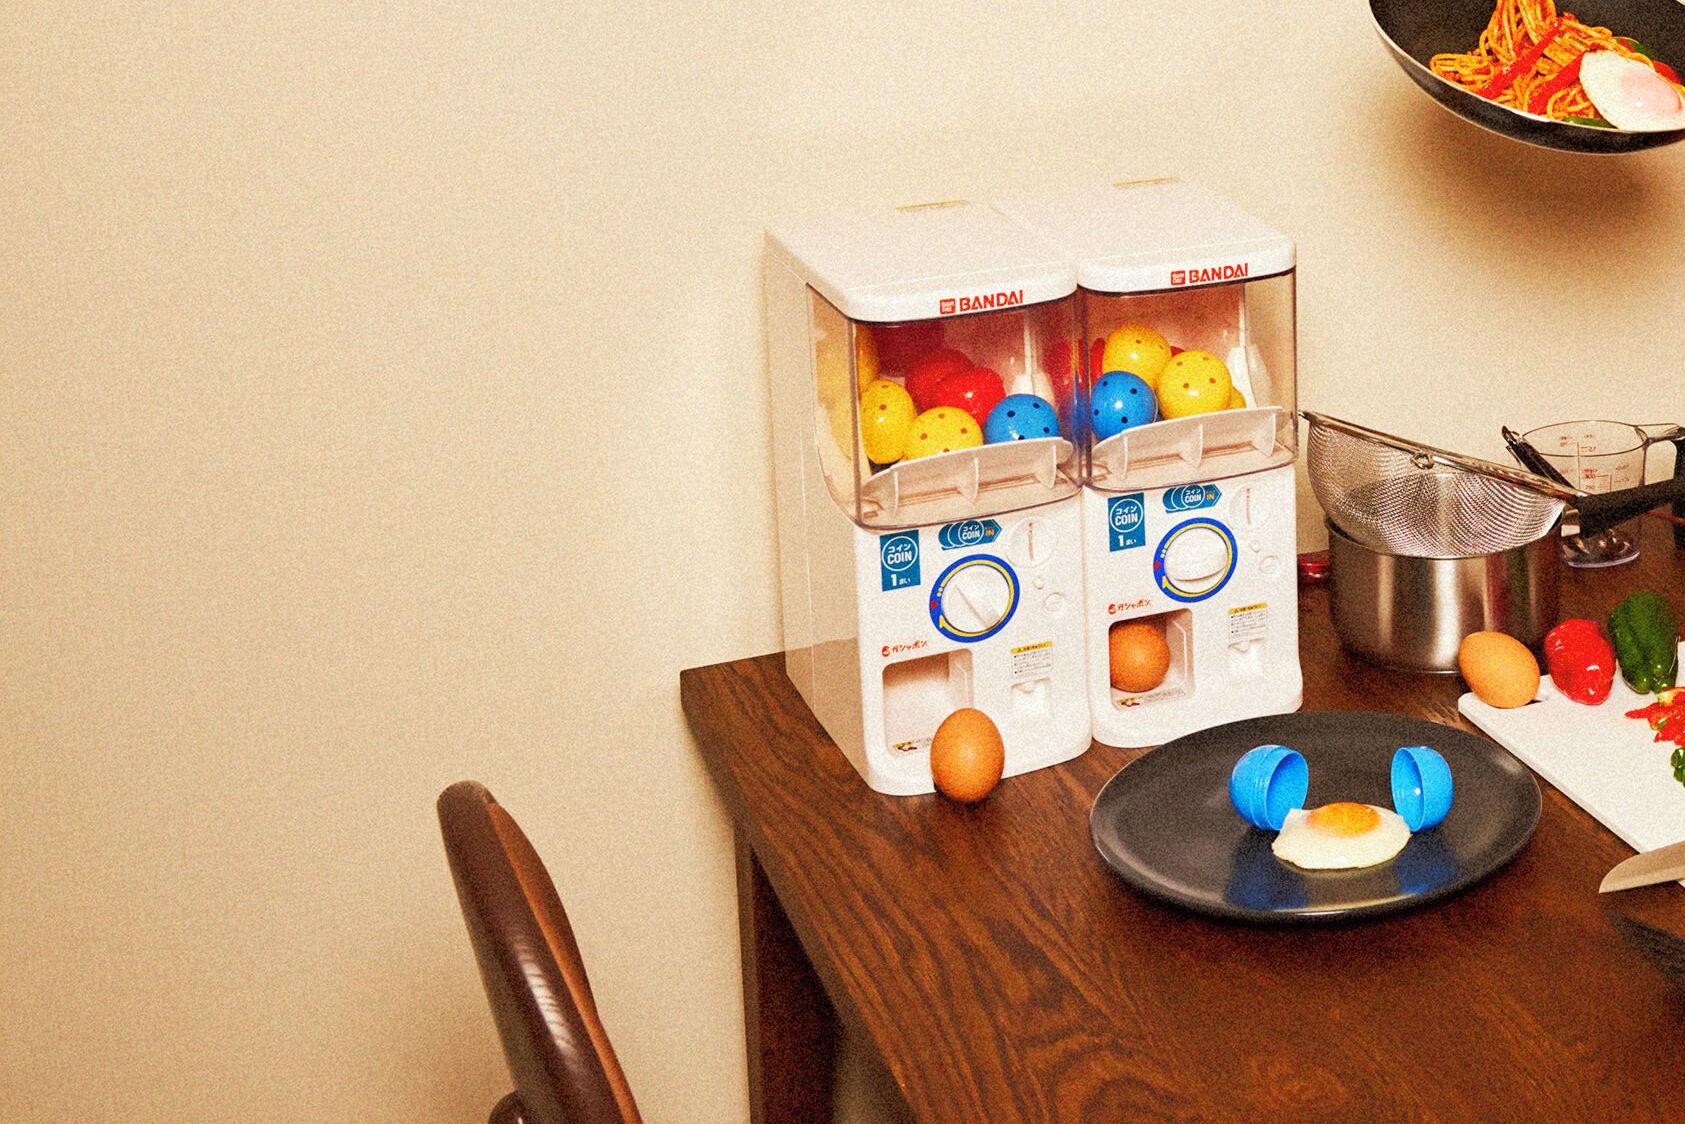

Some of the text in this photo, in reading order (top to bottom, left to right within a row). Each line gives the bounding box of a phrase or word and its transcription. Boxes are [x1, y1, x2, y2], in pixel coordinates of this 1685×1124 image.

[1189, 263, 1248, 284] BANDAI
[960, 290, 1023, 312] BANDAI
[1185, 494, 1202, 504] COIN
[1115, 505, 1138, 515] コイン
[1115, 513, 1138, 526] COIN
[963, 524, 980, 532] コイン
[962, 530, 980, 540] COIN
[888, 543, 911, 554] コイン
[887, 551, 912, 565] COIN
